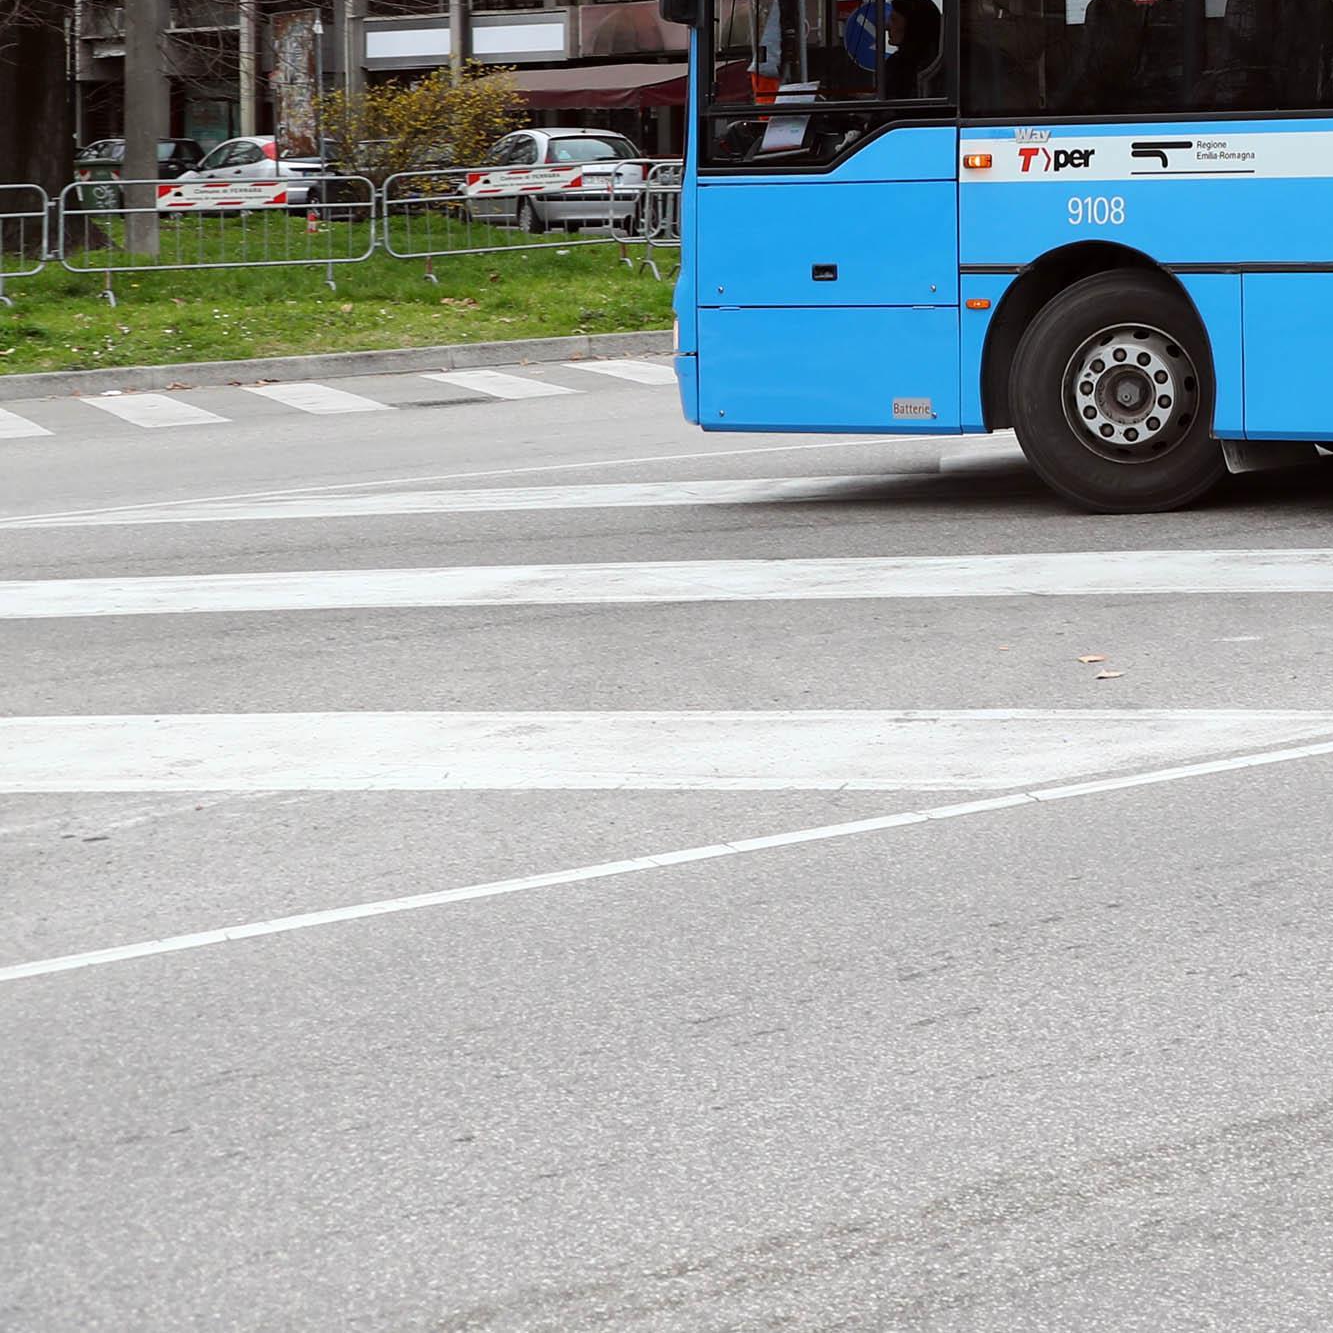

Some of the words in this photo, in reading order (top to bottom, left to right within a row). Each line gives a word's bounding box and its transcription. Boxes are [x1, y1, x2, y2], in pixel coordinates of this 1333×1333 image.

[1014, 127, 1052, 143] Way
[1196, 140, 1227, 151] Regione
[1196, 151, 1255, 161] Emilia-Romagna
[1067, 196, 1125, 225] 9108
[893, 402, 930, 415] Batterie
